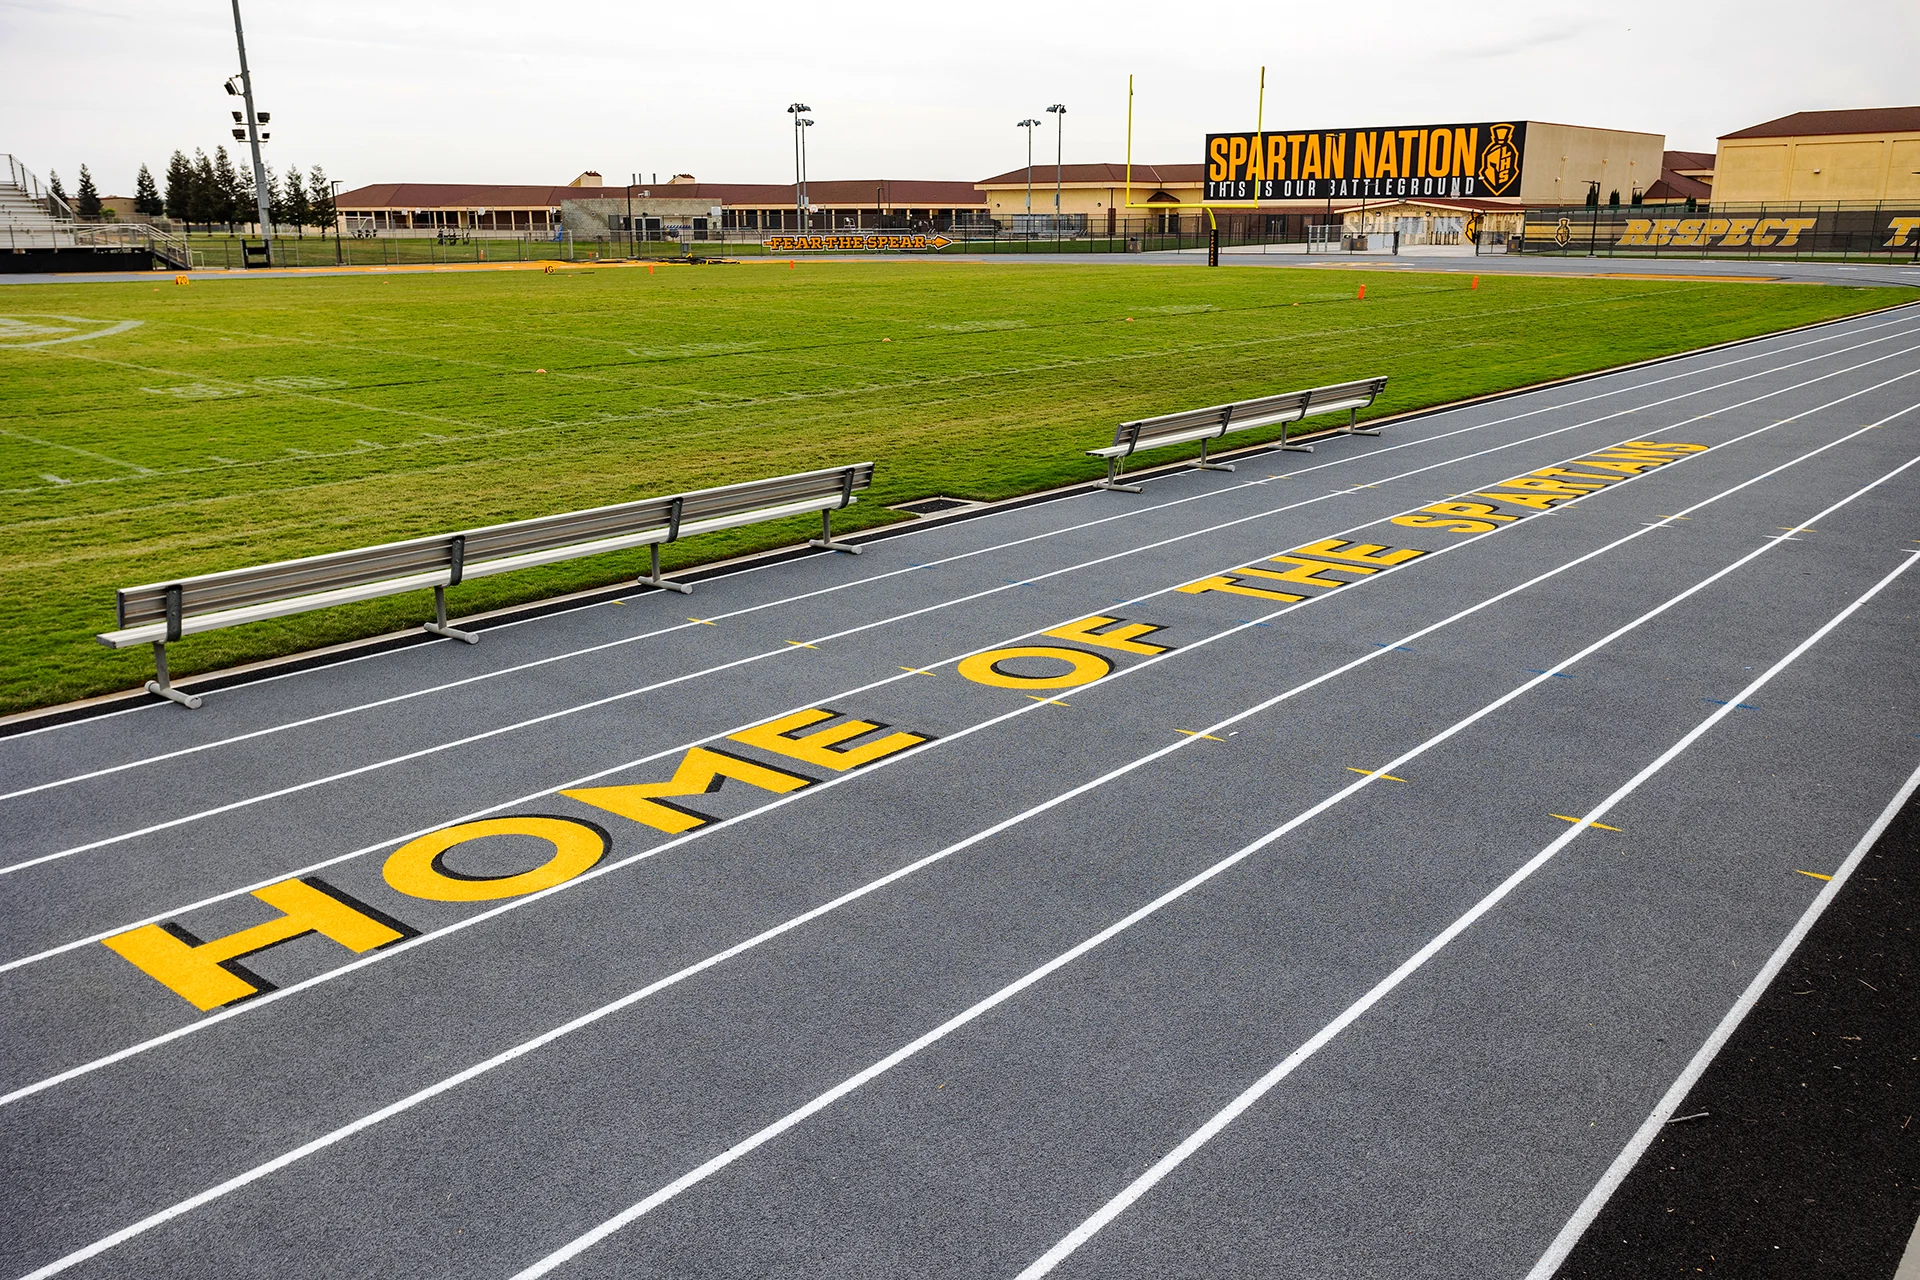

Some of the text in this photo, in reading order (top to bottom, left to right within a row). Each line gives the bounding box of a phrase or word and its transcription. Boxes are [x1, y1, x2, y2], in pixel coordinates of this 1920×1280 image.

[1209, 127, 1478, 181] SPARTAN NATION
[1209, 177, 1475, 197] THIS IS OUR BATTLEGROUND
[771, 236, 927, 250] FEAR THE SPEAR
[1615, 217, 1817, 247] RESPECT
[101, 440, 1710, 1012] HOME OF THE SPARTANS
